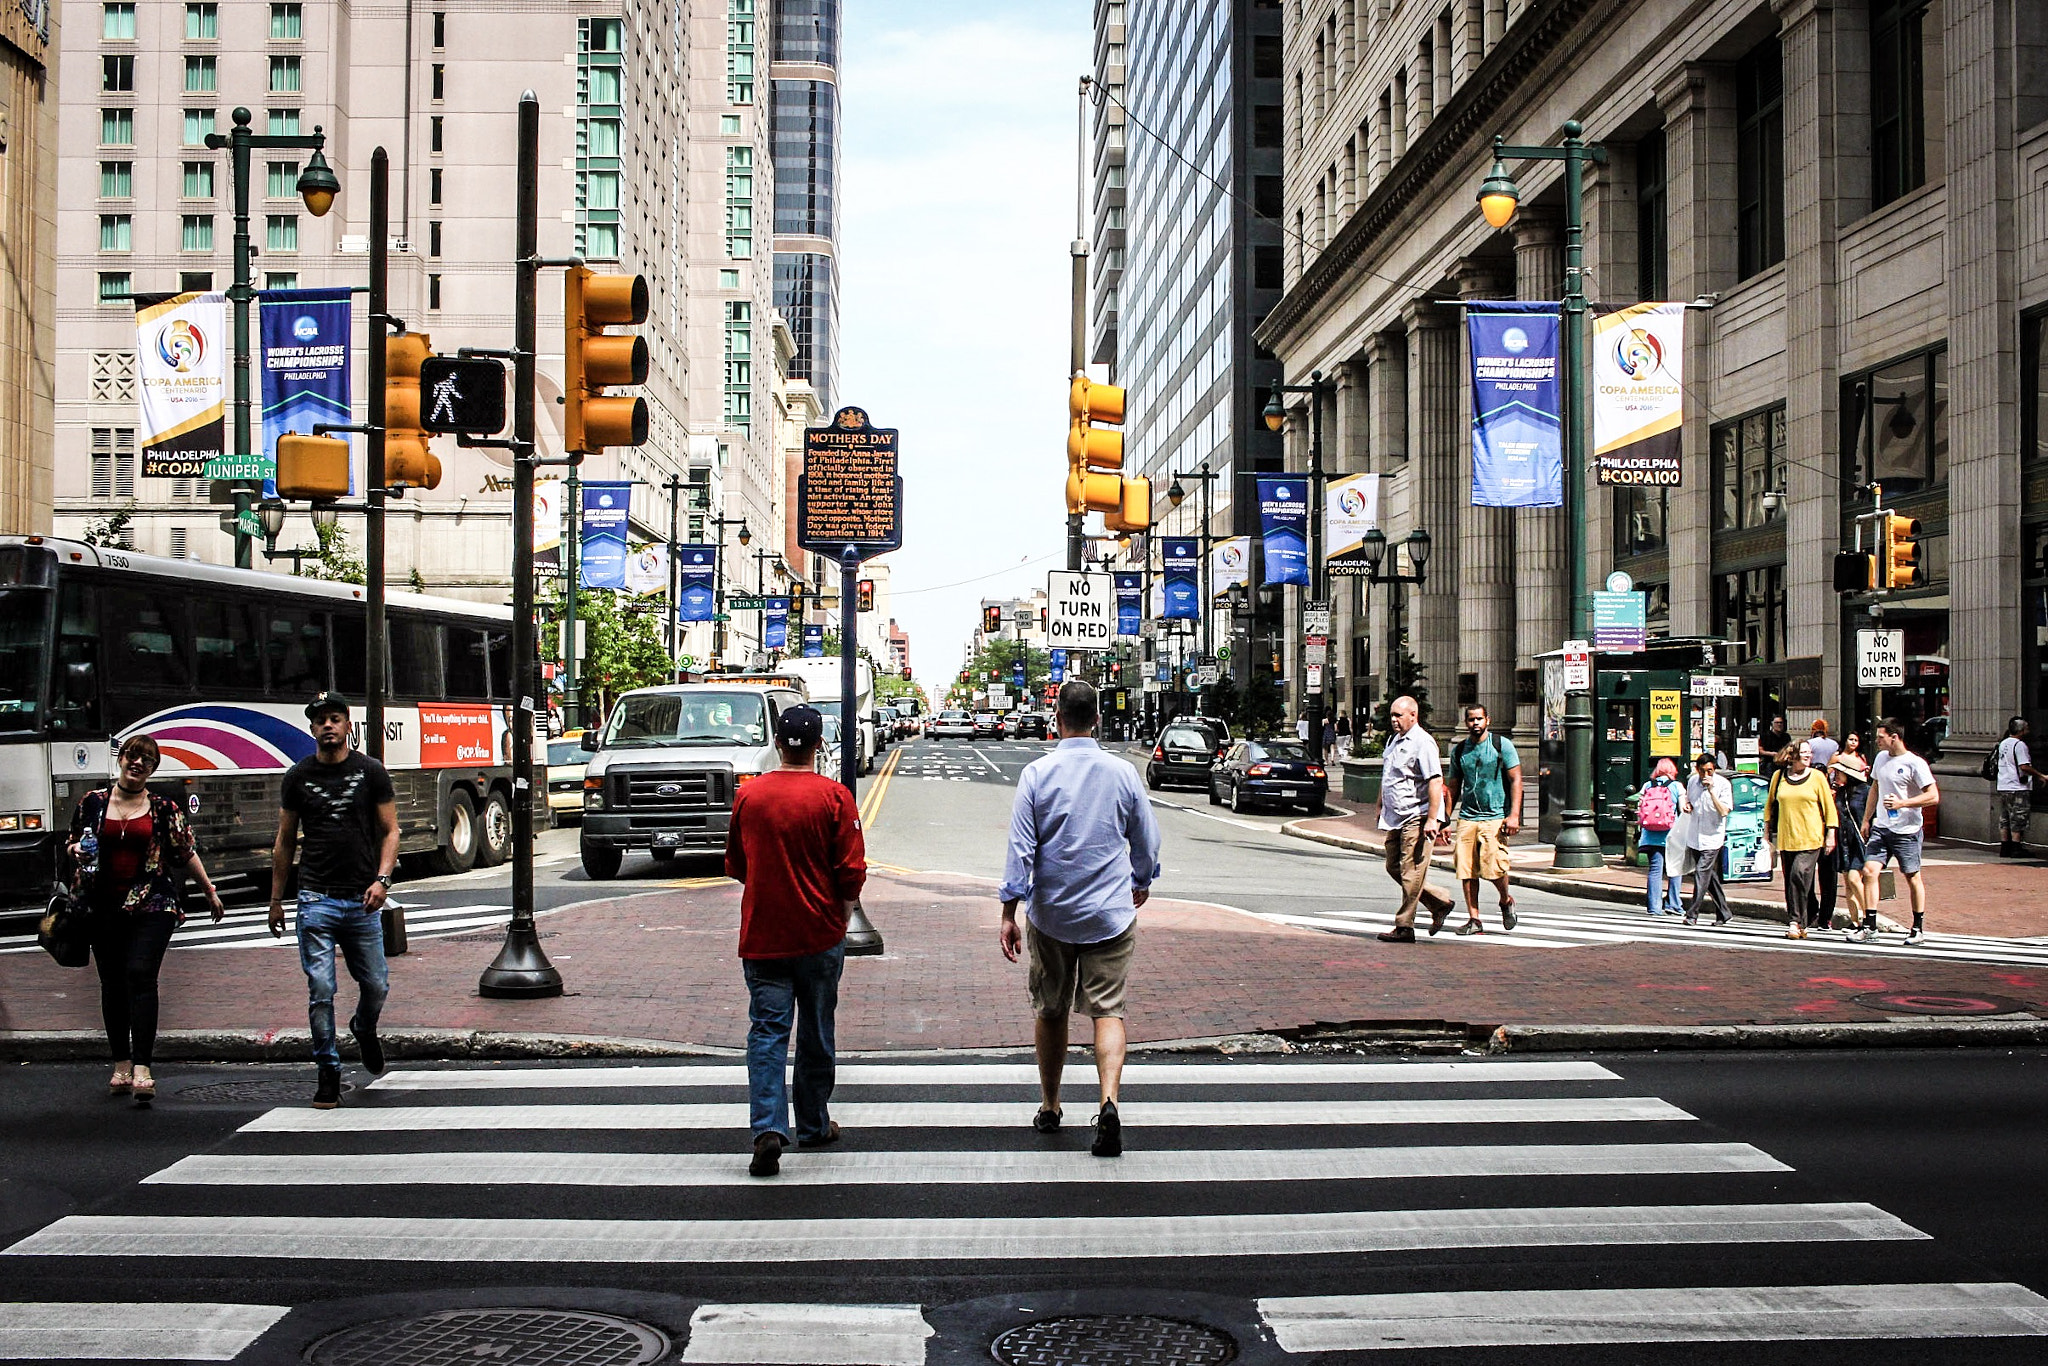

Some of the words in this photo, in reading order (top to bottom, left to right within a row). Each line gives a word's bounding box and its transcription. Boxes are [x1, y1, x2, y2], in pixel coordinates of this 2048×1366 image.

[294, 328, 318, 336] NCAA
[268, 347, 304, 356] WOMEN'S
[305, 346, 344, 355] LACROSSE
[266, 356, 344, 368] CHAMPIONSHIPS
[1477, 358, 1514, 366] WOMEN'S
[1515, 358, 1555, 366] LACROSSE
[284, 372, 326, 380] PHILADELPHIA
[1476, 367, 1555, 378] CHAMPIONSHIPS
[144, 378, 172, 386] COPA
[174, 378, 222, 386] AMERICA
[1600, 386, 1626, 394] COPA
[1630, 386, 1679, 394] AMERICA
[809, 434, 866, 444] MOTHER'S
[870, 434, 894, 444] DAY
[148, 450, 220, 460] PHILADELPHIA
[840, 449, 850, 458] by
[820, 456, 872, 466] Philadelphia.
[1600, 458, 1678, 469] PHILADELPHIA
[206, 464, 260, 478] JUNIPER
[264, 468, 275, 478] ST
[808, 464, 846, 473] officially
[1600, 469, 1679, 484] #COPA100
[844, 479, 870, 487] family
[240, 517, 260, 536] MARKET
[808, 522, 822, 530] Day
[841, 522, 864, 530] given
[105, 554, 130, 568] 7530
[1070, 580, 1090, 596] NO
[1060, 601, 1100, 616] TURN
[1052, 621, 1072, 636] ON
[1078, 622, 1107, 638] RED
[1874, 636, 1888, 648] NO
[1867, 652, 1896, 662] TURN
[1862, 667, 1876, 678] ON
[1880, 667, 1900, 678] RED
[422, 714, 436, 724] You'll
[436, 714, 442, 724] do
[442, 714, 461, 725] anything
[468, 716, 477, 726] your
[478, 714, 489, 724] child.
[424, 734, 430, 744] So
[430, 734, 439, 744] will
[440, 736, 448, 744] we.
